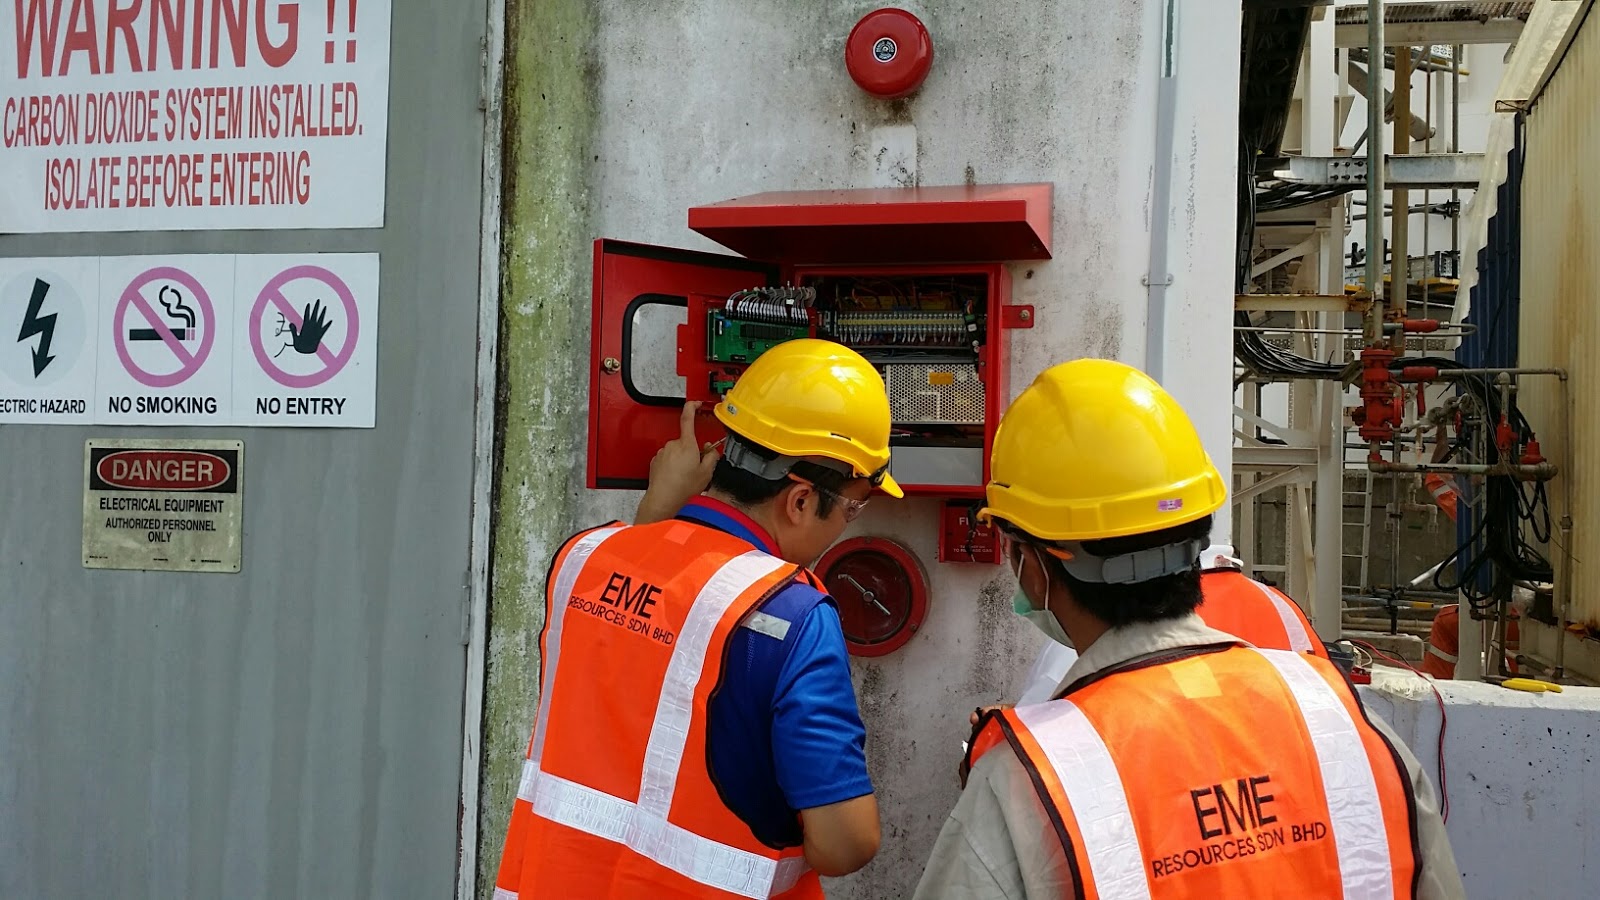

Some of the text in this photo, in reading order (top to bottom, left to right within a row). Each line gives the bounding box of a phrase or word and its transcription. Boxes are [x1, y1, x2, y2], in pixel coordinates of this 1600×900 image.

[14, 0, 300, 79] WARNING
[3, 81, 363, 148] CARBON DIOXIDE SYSTEM INSTALLED.
[44, 150, 311, 211] ISOLATE BEFORE ENTERING
[40, 399, 86, 414] HAZARD
[108, 396, 217, 414] NO SMOKING
[256, 397, 347, 415] NO ENTRY
[112, 459, 214, 482] DANGER
[99, 498, 225, 513] ELECTRICAL EQUIPMENT
[105, 517, 217, 532] AUTHORIZED PERSONNEL
[148, 530, 172, 543] ONLY
[599, 571, 663, 620] EME
[568, 596, 675, 645] RESOURCES SDN BHD
[1190, 775, 1277, 840] EME
[1151, 821, 1328, 879] RESOURCES SDN BHD
